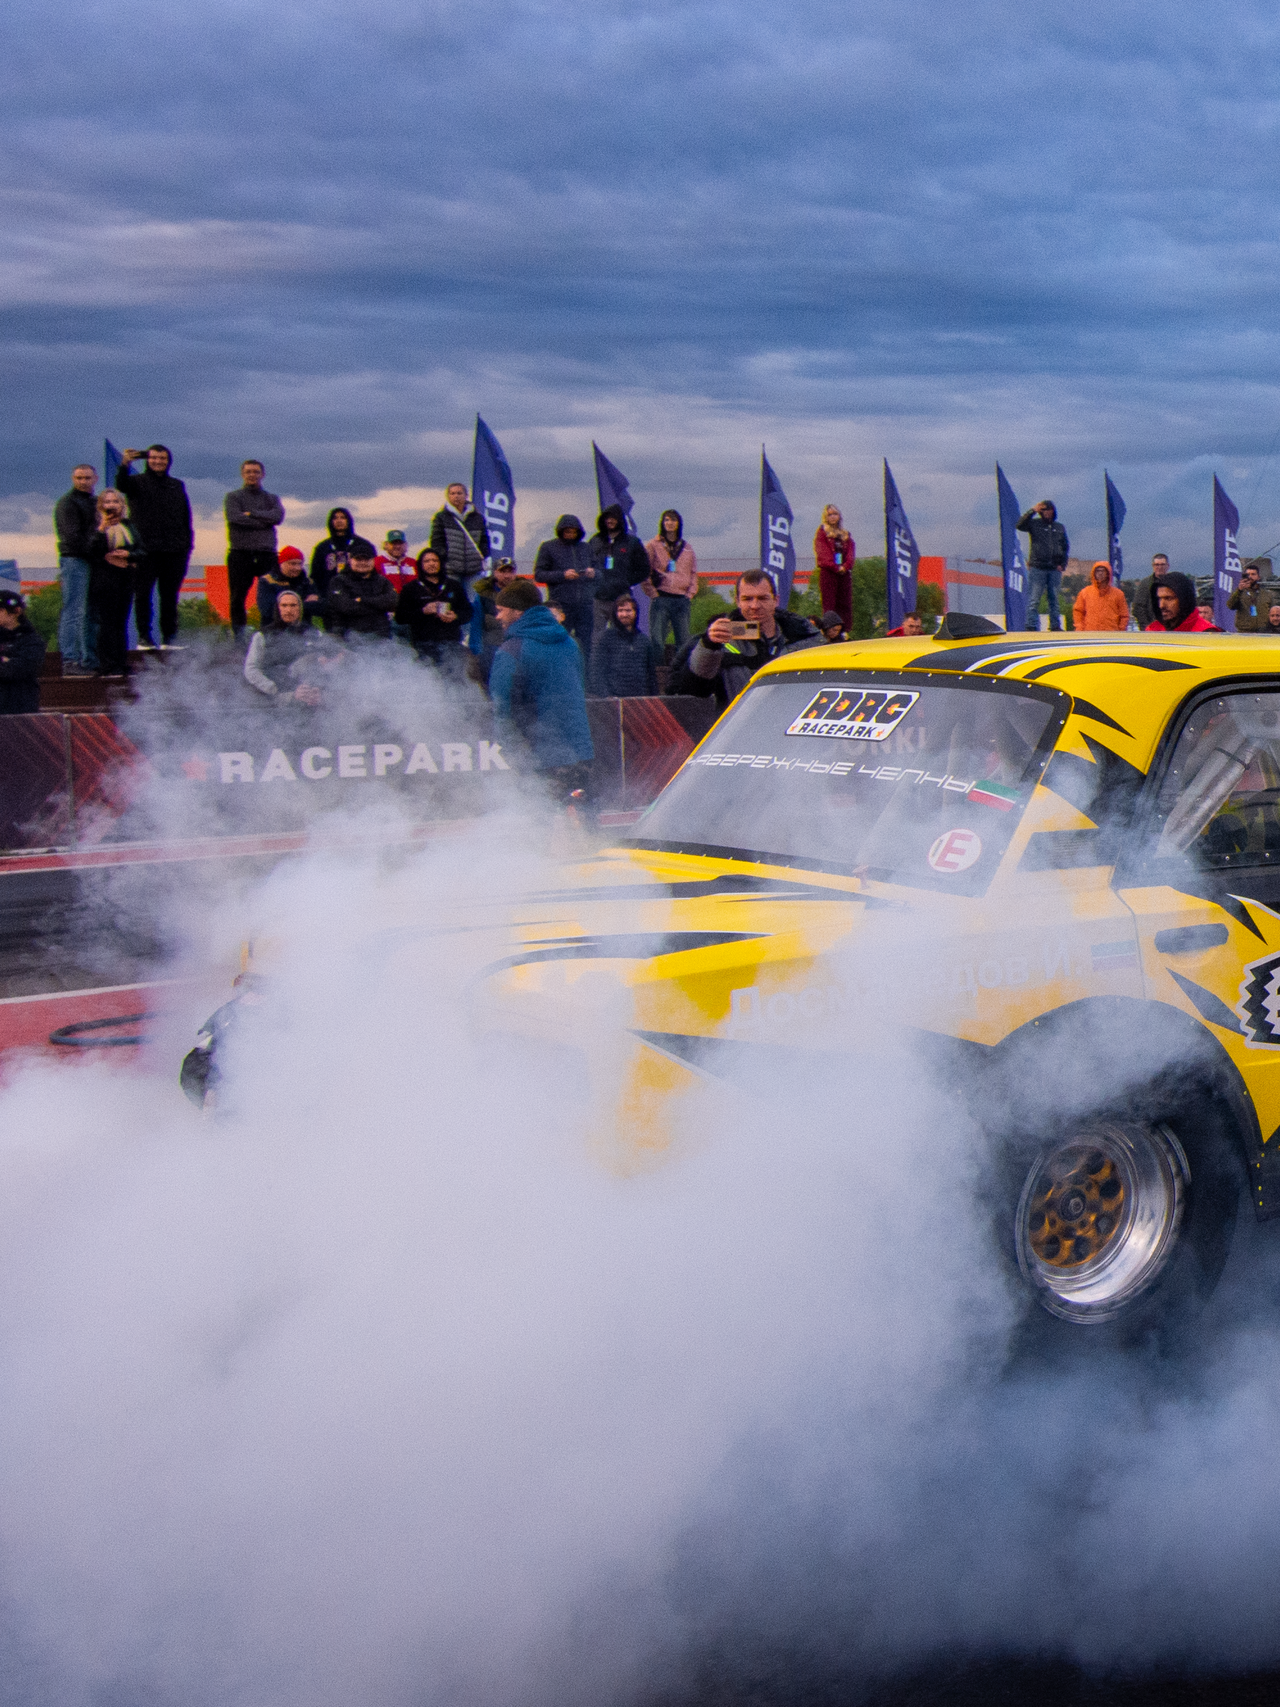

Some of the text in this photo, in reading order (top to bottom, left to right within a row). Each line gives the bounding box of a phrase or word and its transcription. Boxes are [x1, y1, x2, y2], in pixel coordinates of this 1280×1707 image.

[768, 515, 790, 570] ВТБ
[800, 691, 912, 724] RDRC
[798, 723, 878, 738] RACEPARK
[218, 740, 511, 784] RACEPARK
[857, 763, 977, 794] ЧЕЛНЫ
[935, 832, 974, 870] E
